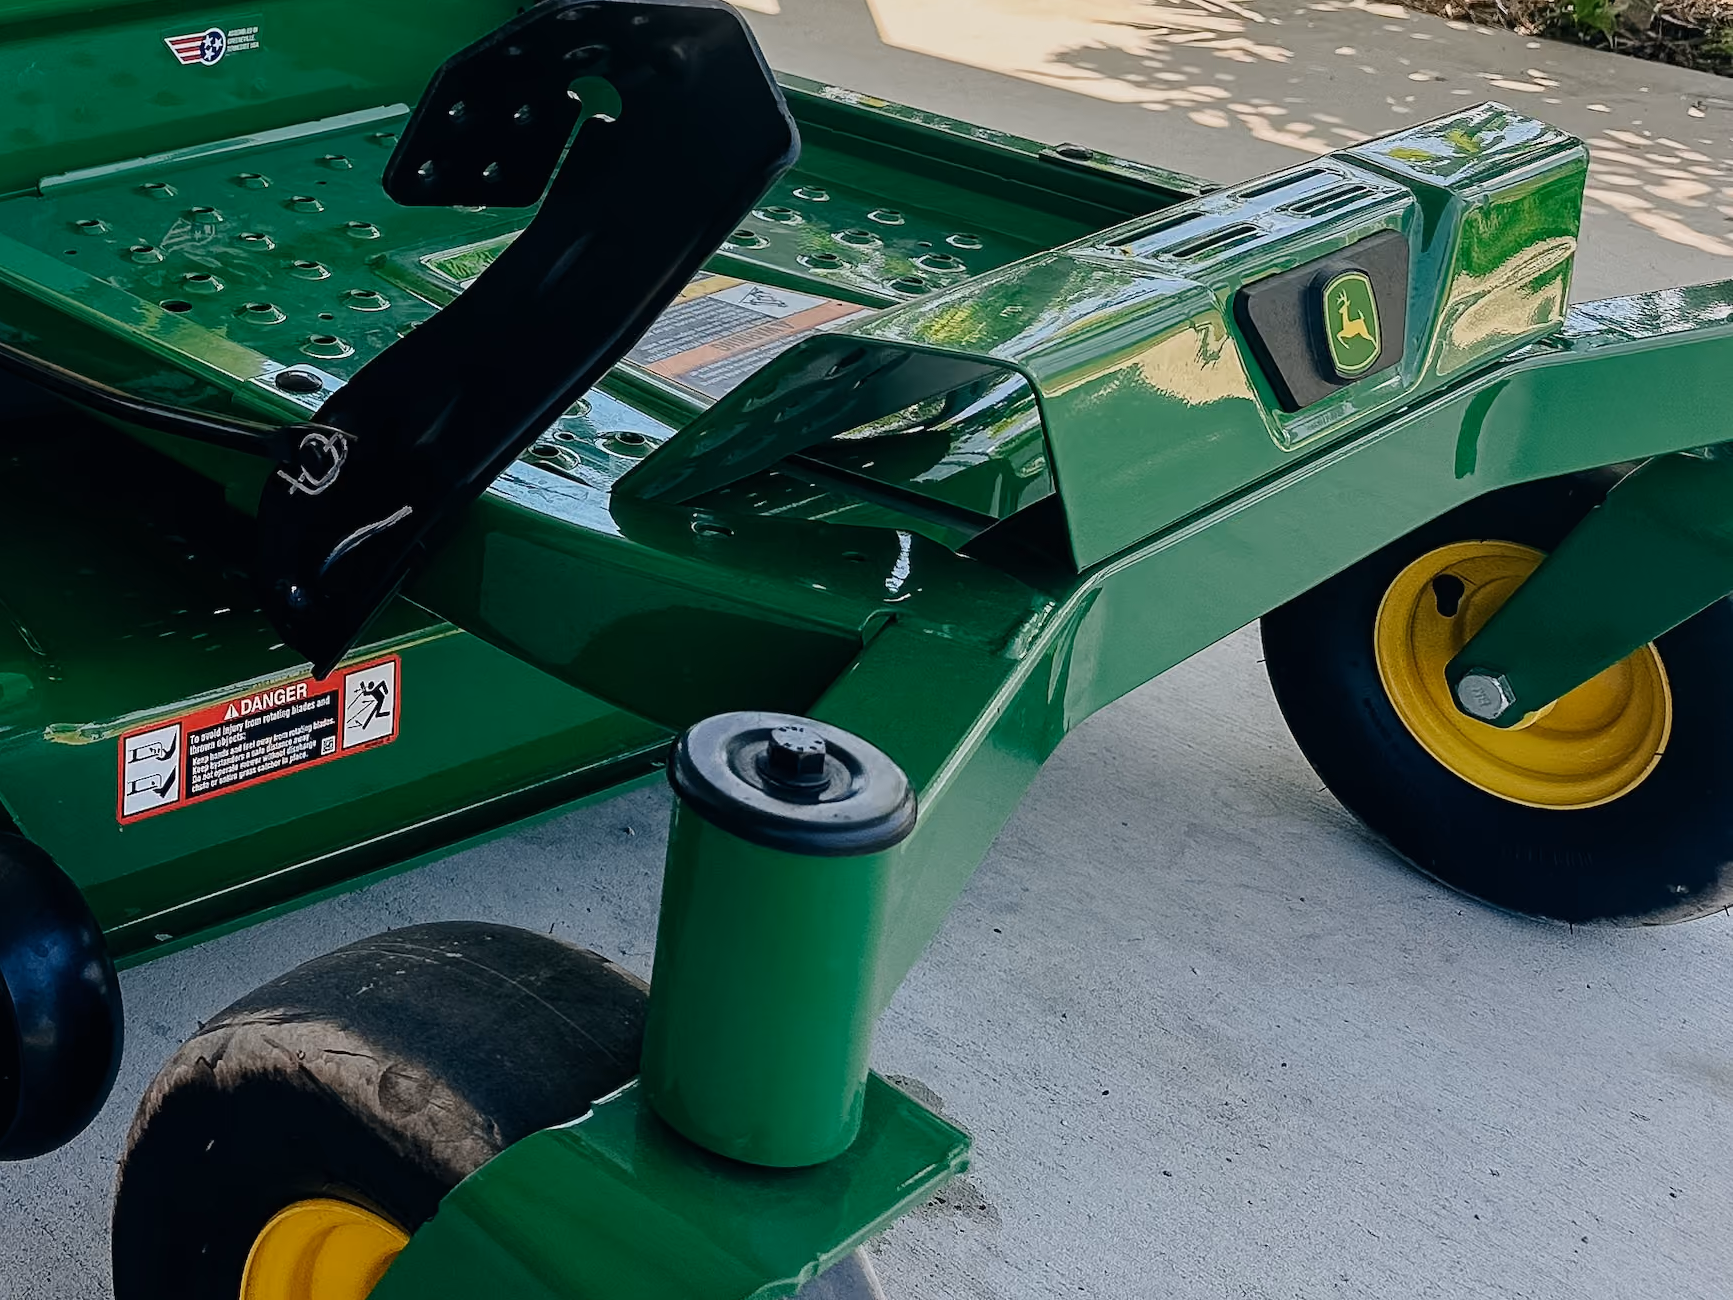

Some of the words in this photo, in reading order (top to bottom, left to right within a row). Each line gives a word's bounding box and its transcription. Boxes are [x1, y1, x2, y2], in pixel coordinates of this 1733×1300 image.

[240, 683, 308, 715] DANGER
[190, 735, 199, 744] To
[201, 727, 221, 741] avoid
[245, 716, 261, 729] from
[263, 709, 290, 724] rotating
[291, 701, 315, 715] blades
[317, 695, 330, 707] and
[190, 741, 215, 755] thrown
